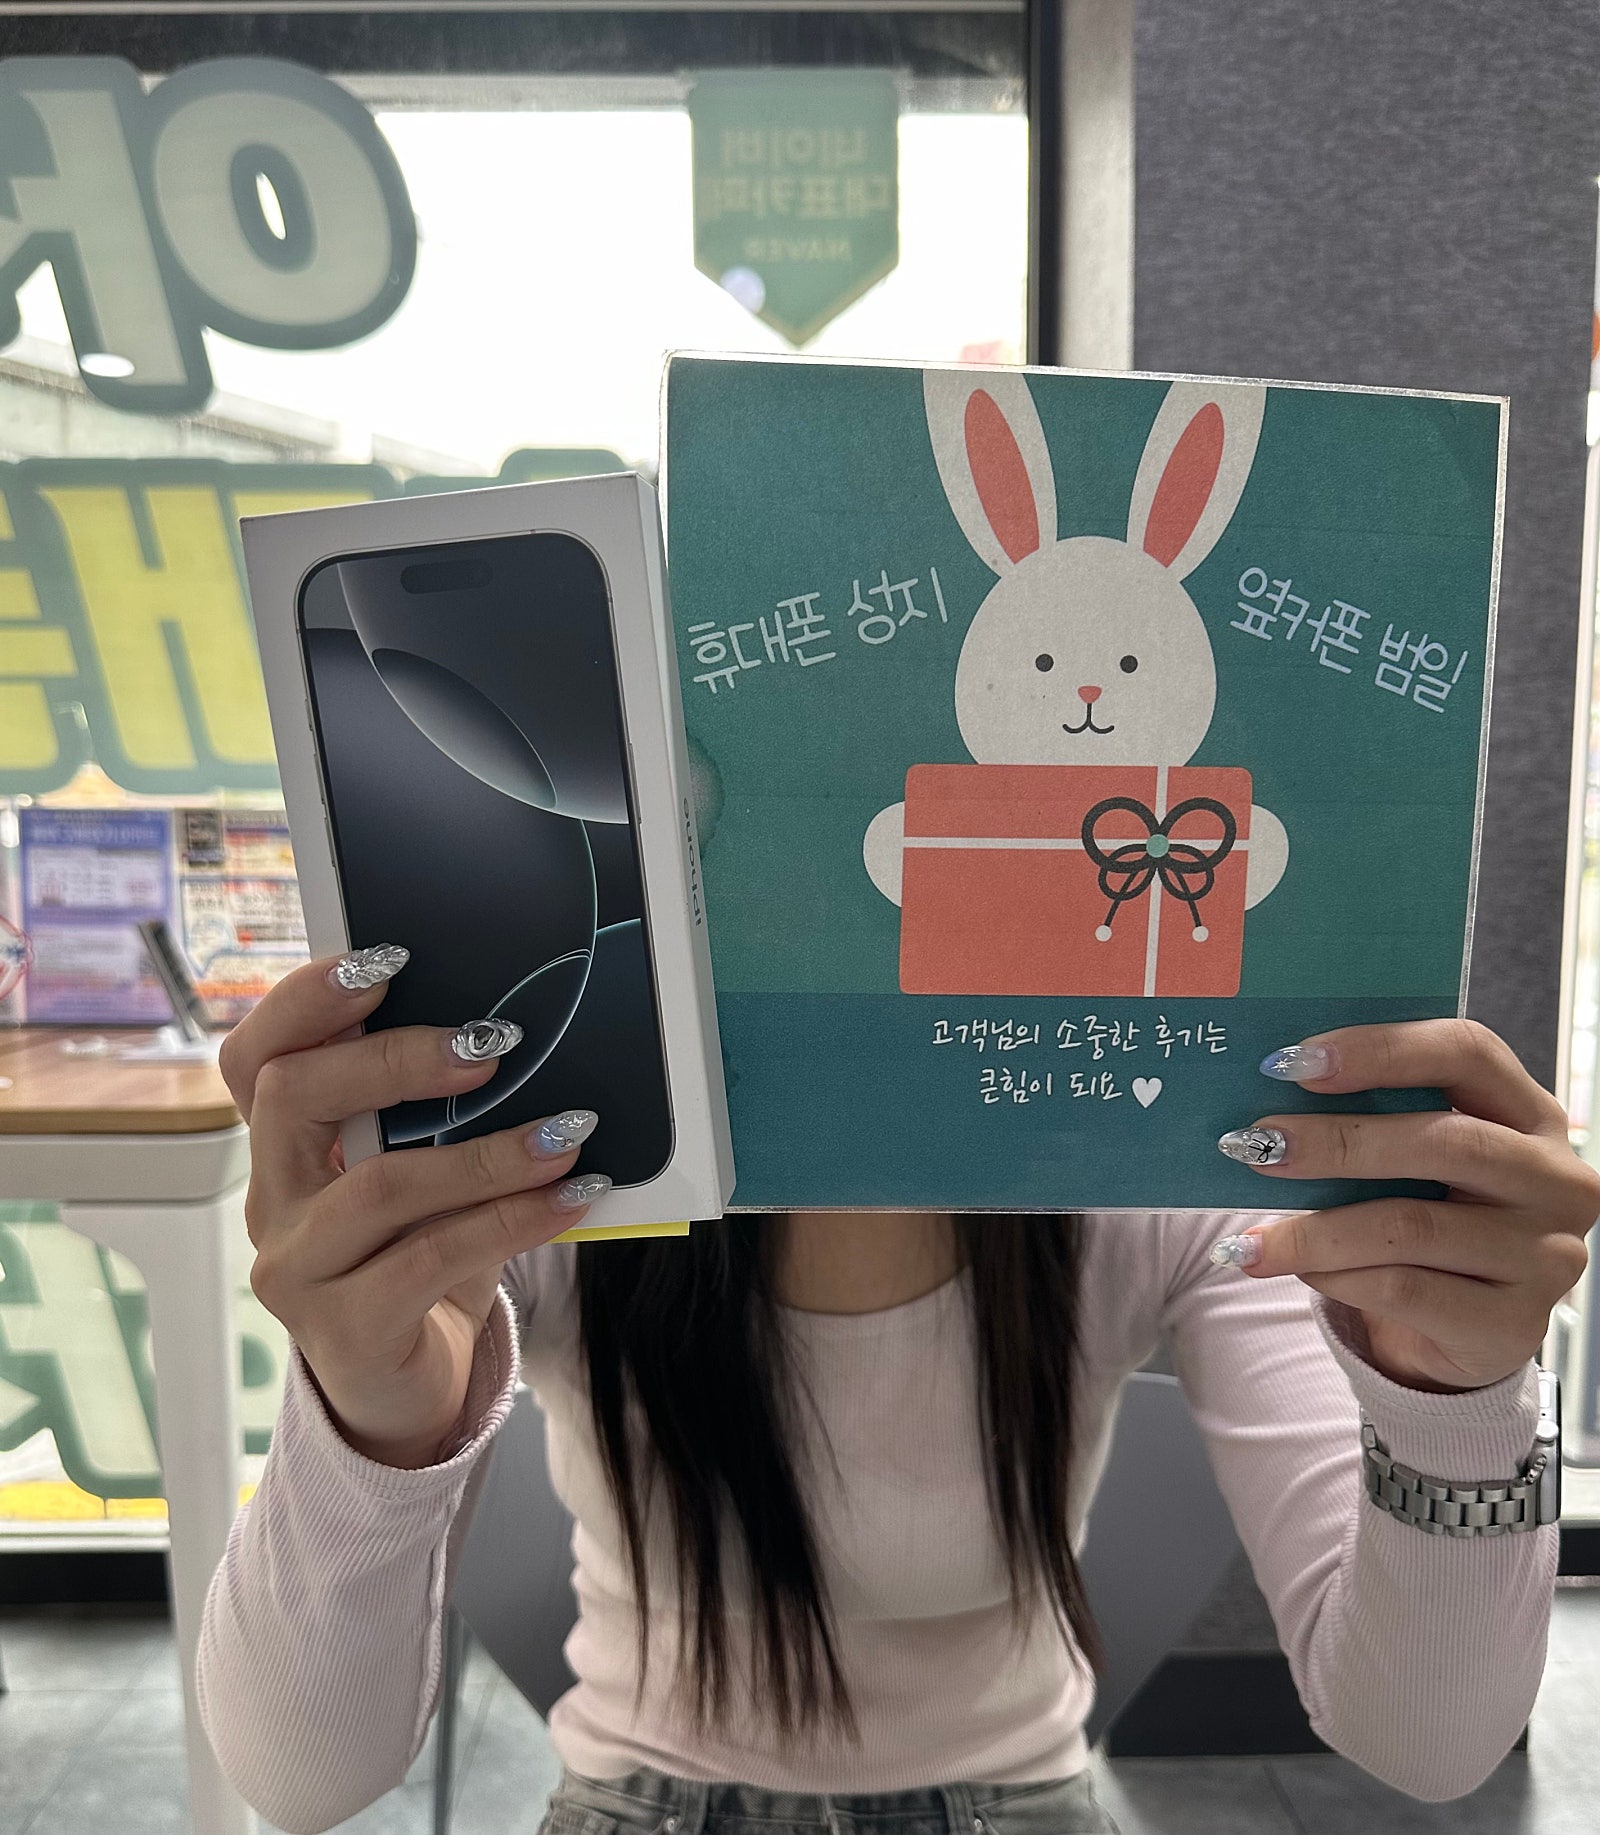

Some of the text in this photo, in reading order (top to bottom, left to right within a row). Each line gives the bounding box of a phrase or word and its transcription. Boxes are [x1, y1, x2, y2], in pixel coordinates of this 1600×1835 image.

[687, 566, 948, 694] 휴대폰 성지
[1230, 566, 1469, 714] 옆커폰 범일
[932, 1014, 1228, 1060] 고객님의 소중한 후기는
[979, 1067, 1123, 1104] 큰힘이 되요
